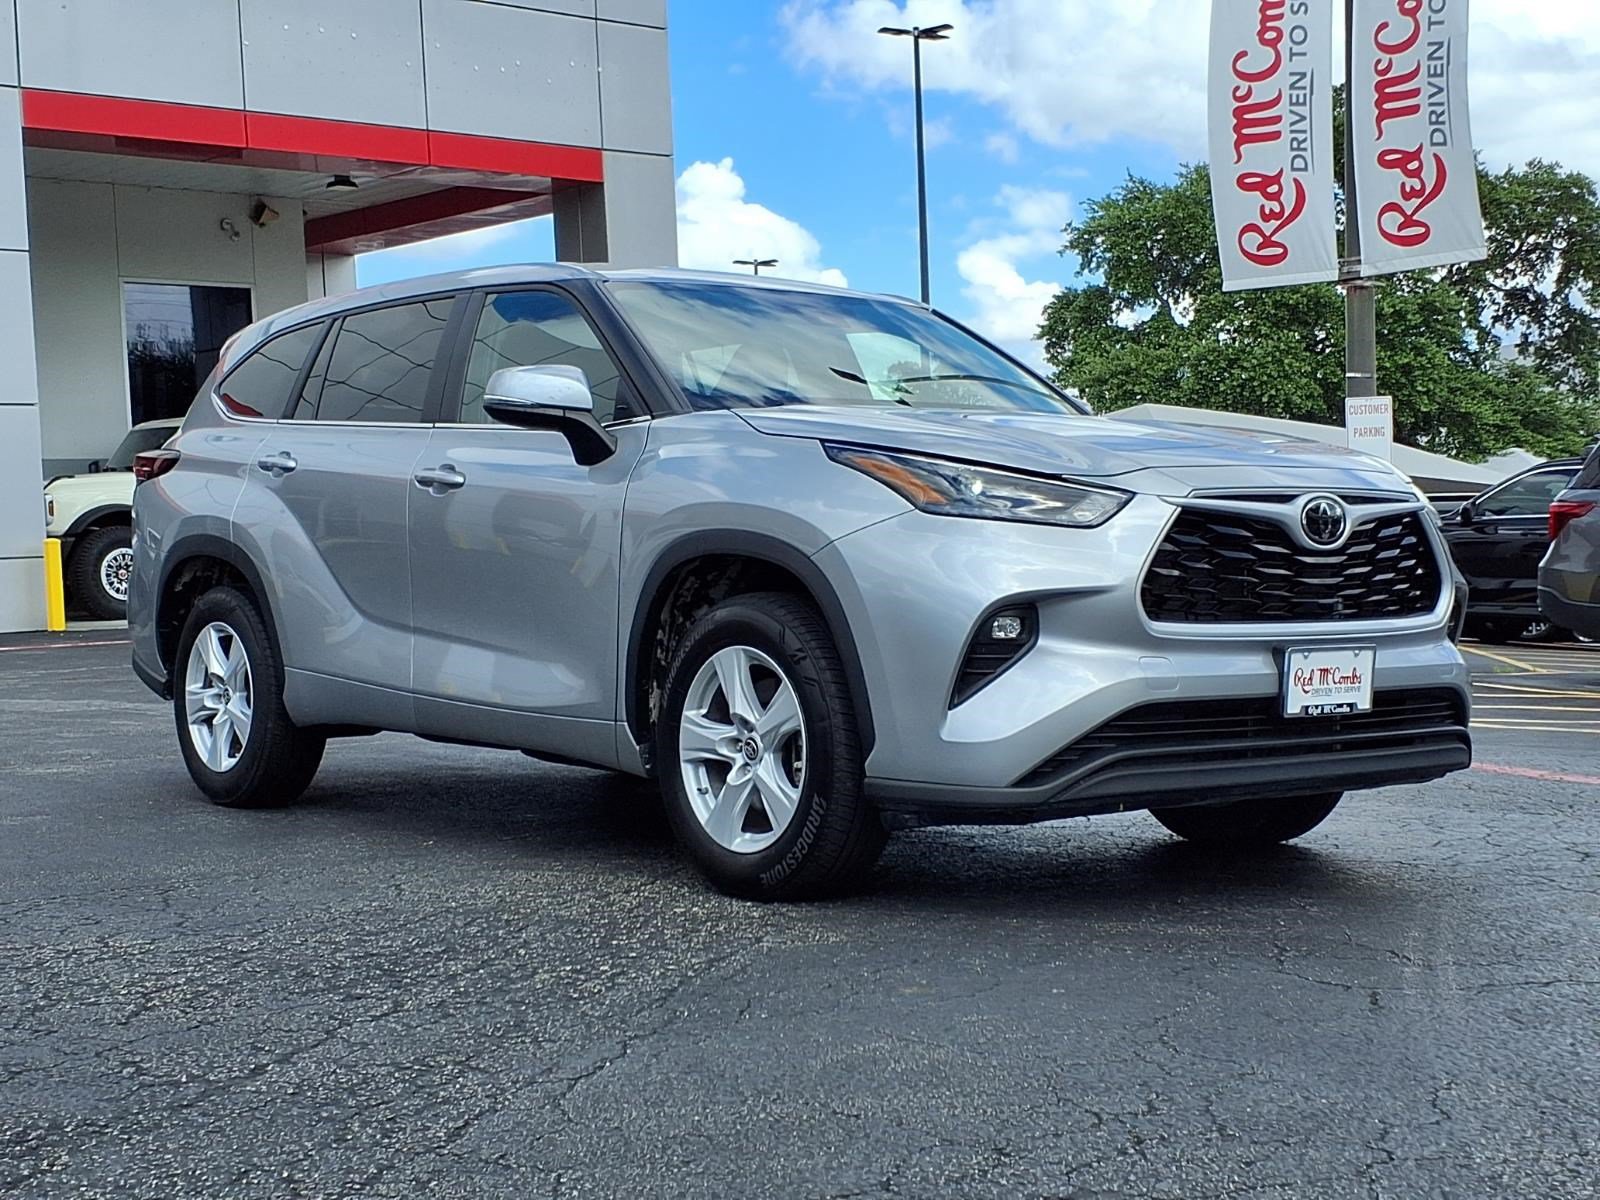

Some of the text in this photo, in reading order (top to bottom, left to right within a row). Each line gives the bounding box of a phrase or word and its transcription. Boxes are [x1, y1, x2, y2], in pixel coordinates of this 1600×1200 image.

[1289, 24, 1309, 63] TO
[1427, 40, 1448, 148] DRIVEN
[1231, 0, 1306, 267] Red McCom
[1289, 70, 1309, 173] DRIVEN
[1373, 0, 1448, 248] Red McCo
[1349, 404, 1389, 415] CUSTOMER
[1354, 427, 1385, 438] PARKING
[1294, 666, 1362, 694] Red McCombs
[1311, 686, 1361, 696] DRIVEN TO SERVE
